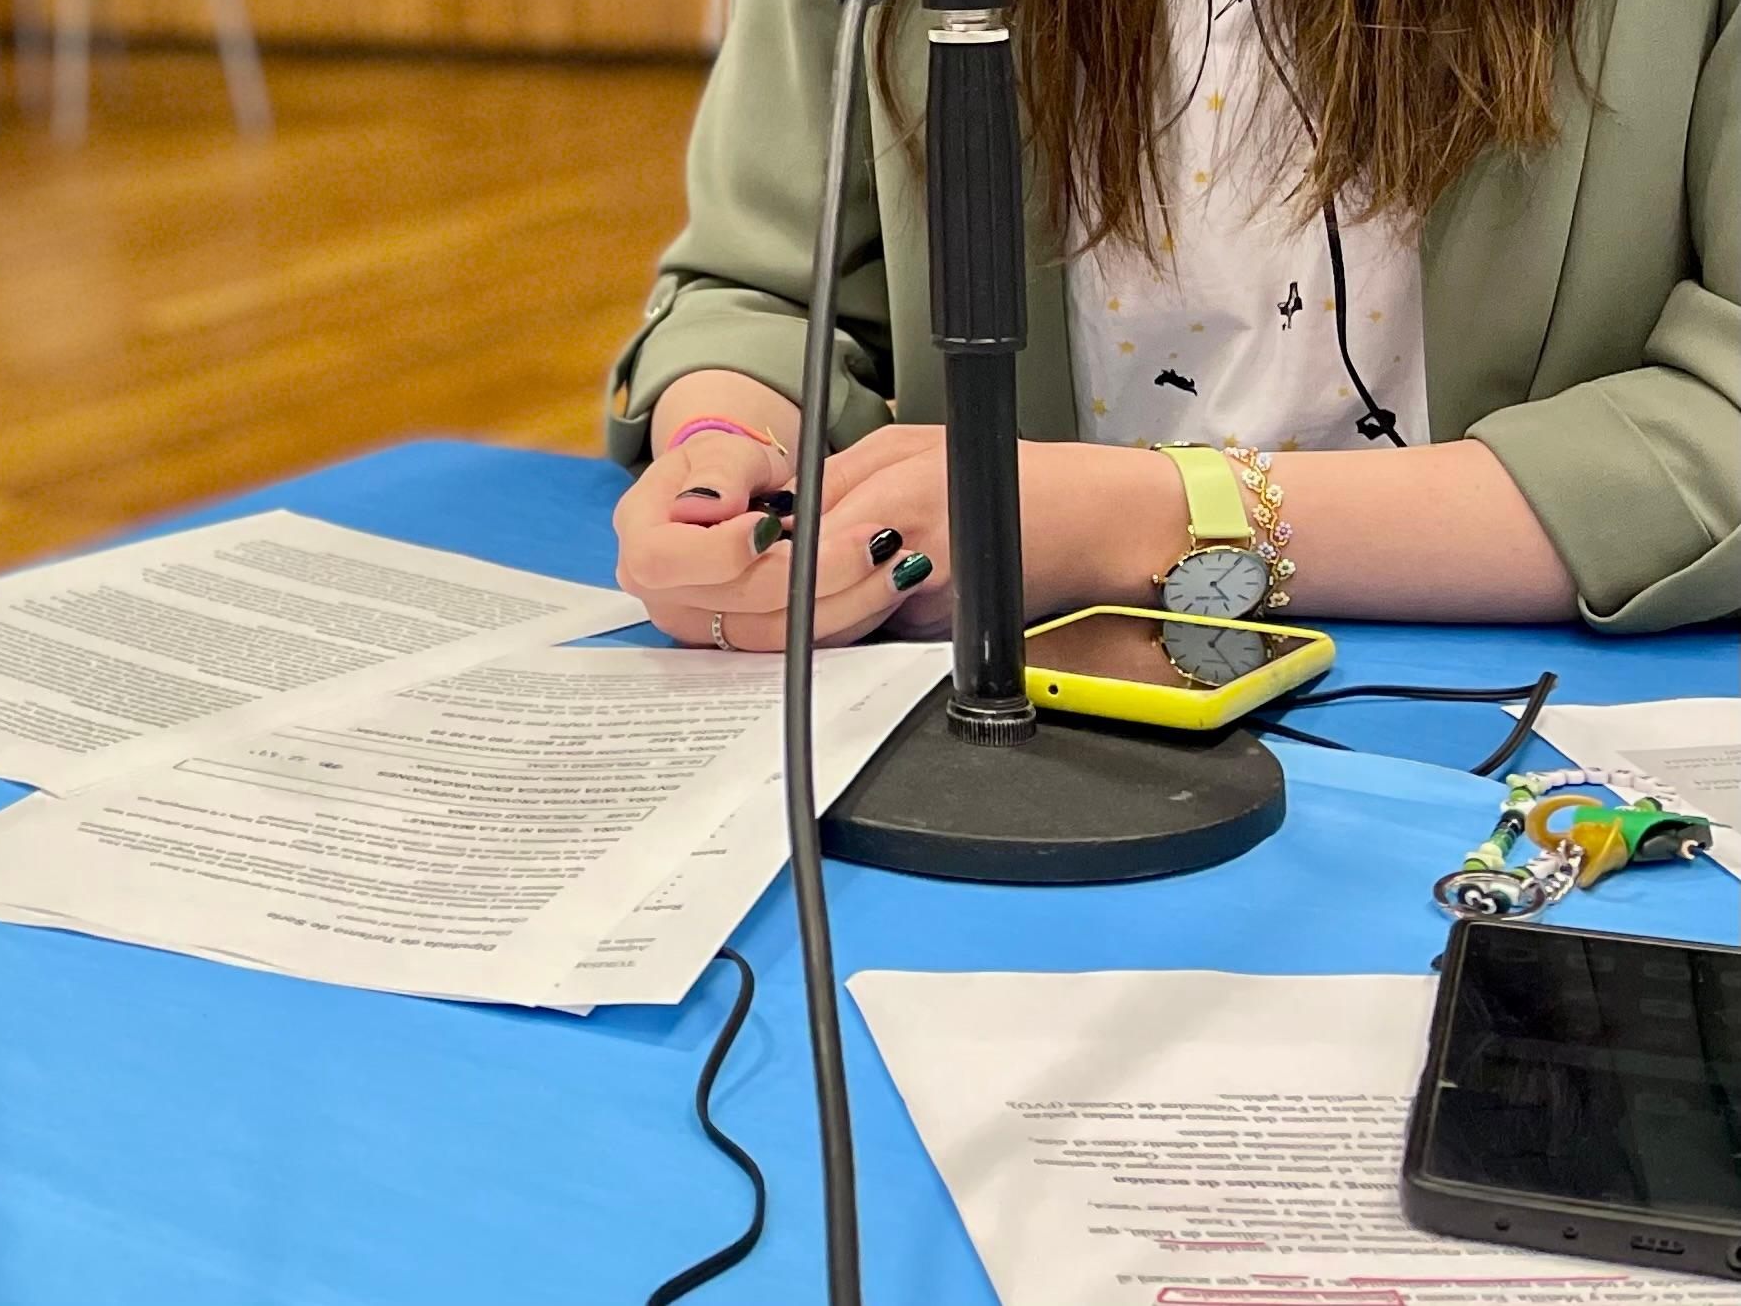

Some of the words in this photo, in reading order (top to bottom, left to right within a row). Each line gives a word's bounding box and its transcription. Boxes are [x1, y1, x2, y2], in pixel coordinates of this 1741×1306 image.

[333, 927, 395, 944] Turismo
[1137, 1102, 1154, 1110] de
[1160, 1103, 1237, 1112] Vehículos
[1062, 1150, 1158, 1160] Organizado
[1113, 1176, 1189, 1186] ocasión
[1196, 1180, 1220, 1188] de
[1225, 1180, 1323, 1190] vehículos
[1329, 1180, 1339, 1189] y
